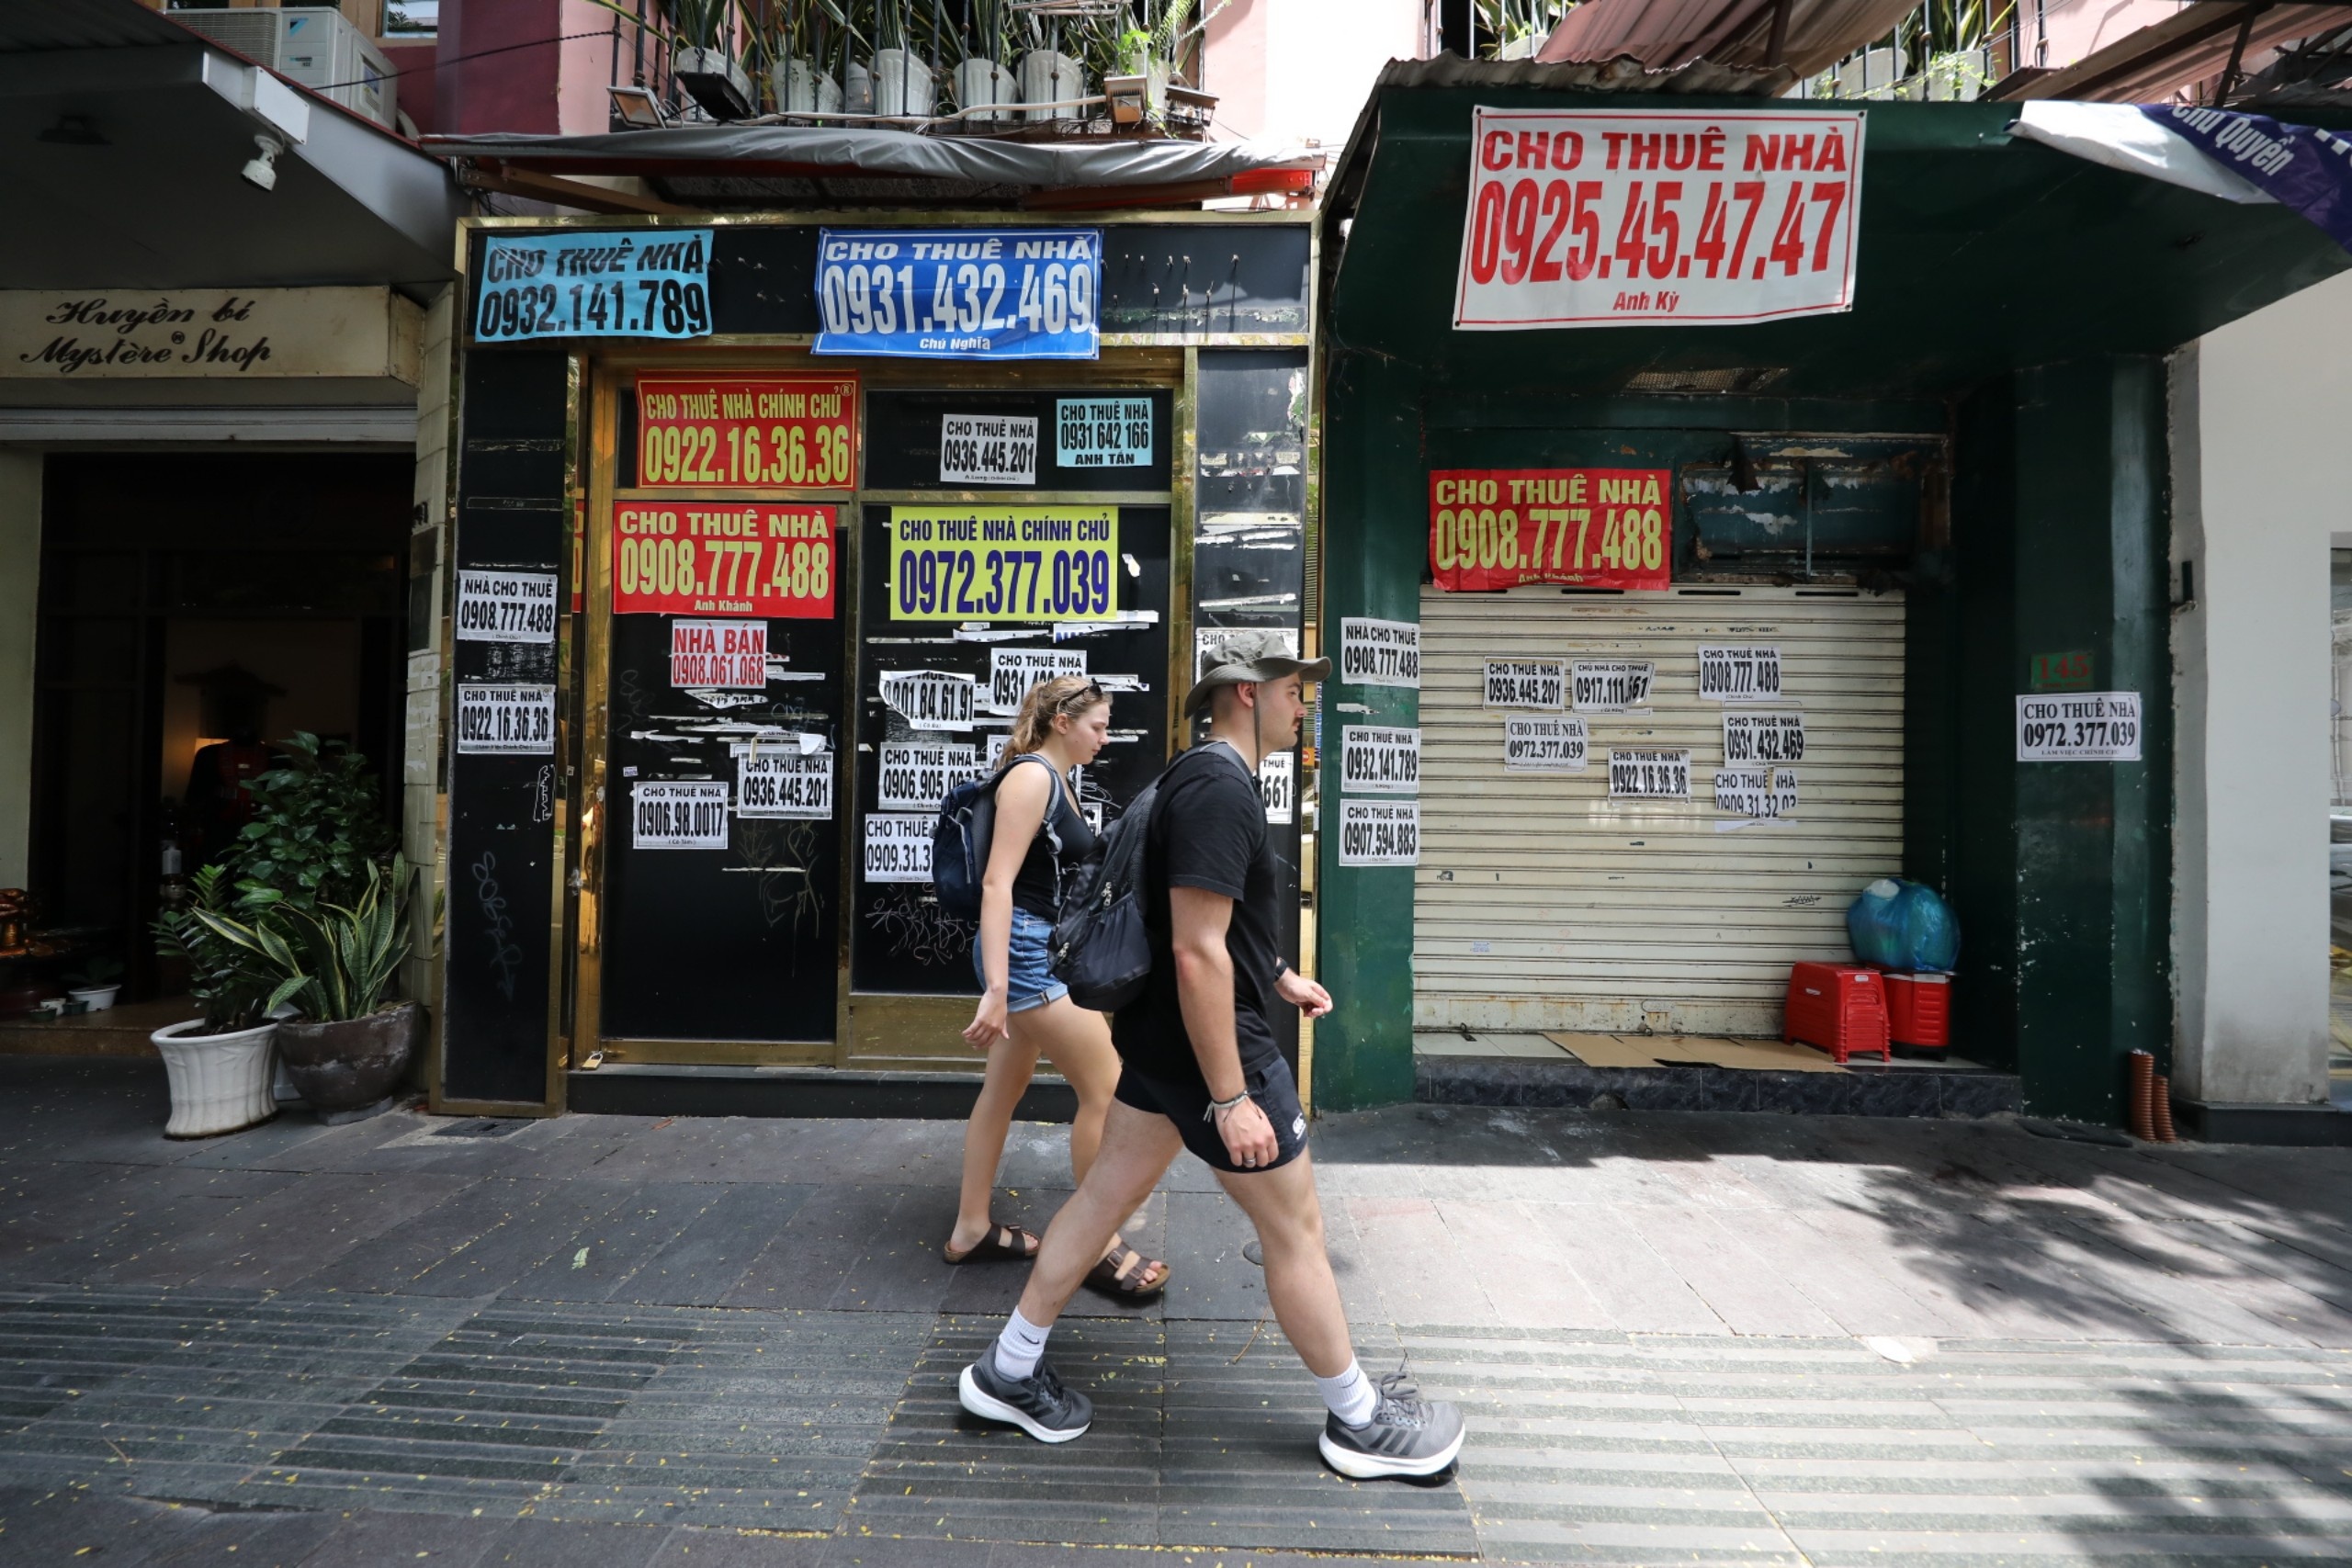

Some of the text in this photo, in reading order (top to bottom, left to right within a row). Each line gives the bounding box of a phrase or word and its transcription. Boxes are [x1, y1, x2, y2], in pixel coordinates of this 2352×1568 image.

[1481, 127, 1847, 173] CHO THUÊ NHÀ
[2216, 118, 2296, 176] Quyền
[1470, 178, 1846, 286] 0925.45.47.47
[488, 234, 704, 284] CHO THUÊ NHÀ
[825, 236, 1091, 261] CHO THUÊ NHÀ
[480, 279, 708, 337] 0932.141.789
[824, 264, 1091, 334] 0931.432.469
[1612, 291, 1679, 312] Anh Kỳ
[46, 297, 255, 333] Huyền bí
[20, 336, 173, 373] Mystère
[182, 329, 270, 371] Shop
[920, 337, 990, 350] Chú Nghĩa
[646, 394, 677, 419] CHO
[680, 390, 718, 419] THUÊ
[723, 389, 754, 418] NHÀ
[759, 389, 805, 418] CHÍNH
[810, 386, 841, 418] CHỦ
[1061, 400, 1148, 421] CHO THUÊ NHÀ
[947, 420, 1034, 438] CHO THUÊ NHÀ
[1061, 422, 1148, 449] 0931 642 166
[646, 425, 849, 483] 0922.16.36.36
[944, 439, 1034, 473] 0936.445.201
[1075, 454, 1102, 464] ANH
[1436, 471, 1661, 505] CHO THUÊ NHÀ
[620, 509, 829, 538] CHO THUÊ NHÀ
[900, 513, 1109, 540] CHO THUÊ NHÀ CHÍNH CHỦ
[1436, 509, 1661, 570] 0908.777.488
[620, 537, 829, 599] 0908.777.488
[1518, 573, 1542, 583] Anh
[465, 575, 552, 597] NHÀ CHO THUÊ
[900, 550, 1109, 614] 0972.377.039
[461, 601, 552, 632] 0908.777.488
[695, 600, 752, 612] Anh Khánh
[674, 623, 764, 654] NHÀ BÁN
[1346, 622, 1416, 646] NHÀ CHO THUÊ
[999, 653, 1081, 668] CHO THUÊ NHÀ
[1345, 646, 1418, 678] 0908.777.488
[1727, 648, 1752, 658] THUÊ
[1756, 648, 1776, 658] NHÀ
[673, 655, 763, 685] 0908.061.068
[1489, 661, 1559, 676] CHO THUÊ NHÀ
[1702, 661, 1779, 693] 0908.777.488
[2040, 655, 2089, 680] 145
[464, 689, 543, 702] CHO THUÊ NHÀ
[1489, 679, 1560, 705] 0936.445.201
[1727, 716, 1800, 727] CHO THUÊ NHÀ
[2024, 697, 2135, 719] CHO THUÊ NHÀ
[463, 705, 548, 741] 0922.16.36.36
[1510, 720, 1583, 736] CHO THUÊ NHÀ
[2024, 722, 2135, 747] 0972.377.039
[1350, 732, 1412, 744] CHO THUÊ NHÀ
[1510, 741, 1583, 759] 0972.377.039
[1728, 729, 1804, 760] 0931.432.469
[746, 760, 769, 773] CHO
[885, 750, 910, 765] CHO
[914, 747, 944, 766] THUÊ
[948, 747, 972, 767] NHÀ
[1347, 747, 1417, 782] 0932.141.789
[1613, 752, 1632, 761] CHO
[643, 784, 721, 797] CHO THUÊ NHÀ
[744, 776, 827, 807] 0936.445.201
[1612, 764, 1687, 794] 0922.16.36.36
[1716, 774, 1737, 788] CHO
[1741, 771, 1768, 788] THUÊ
[639, 801, 723, 836] 0906.98.0017
[1348, 806, 1413, 819] CHO THUÊ NHÀ
[866, 820, 892, 837] CHO
[896, 816, 928, 837] THUÊ
[1345, 822, 1416, 855] 0907.594.883
[866, 843, 933, 872] 0909.31.3
